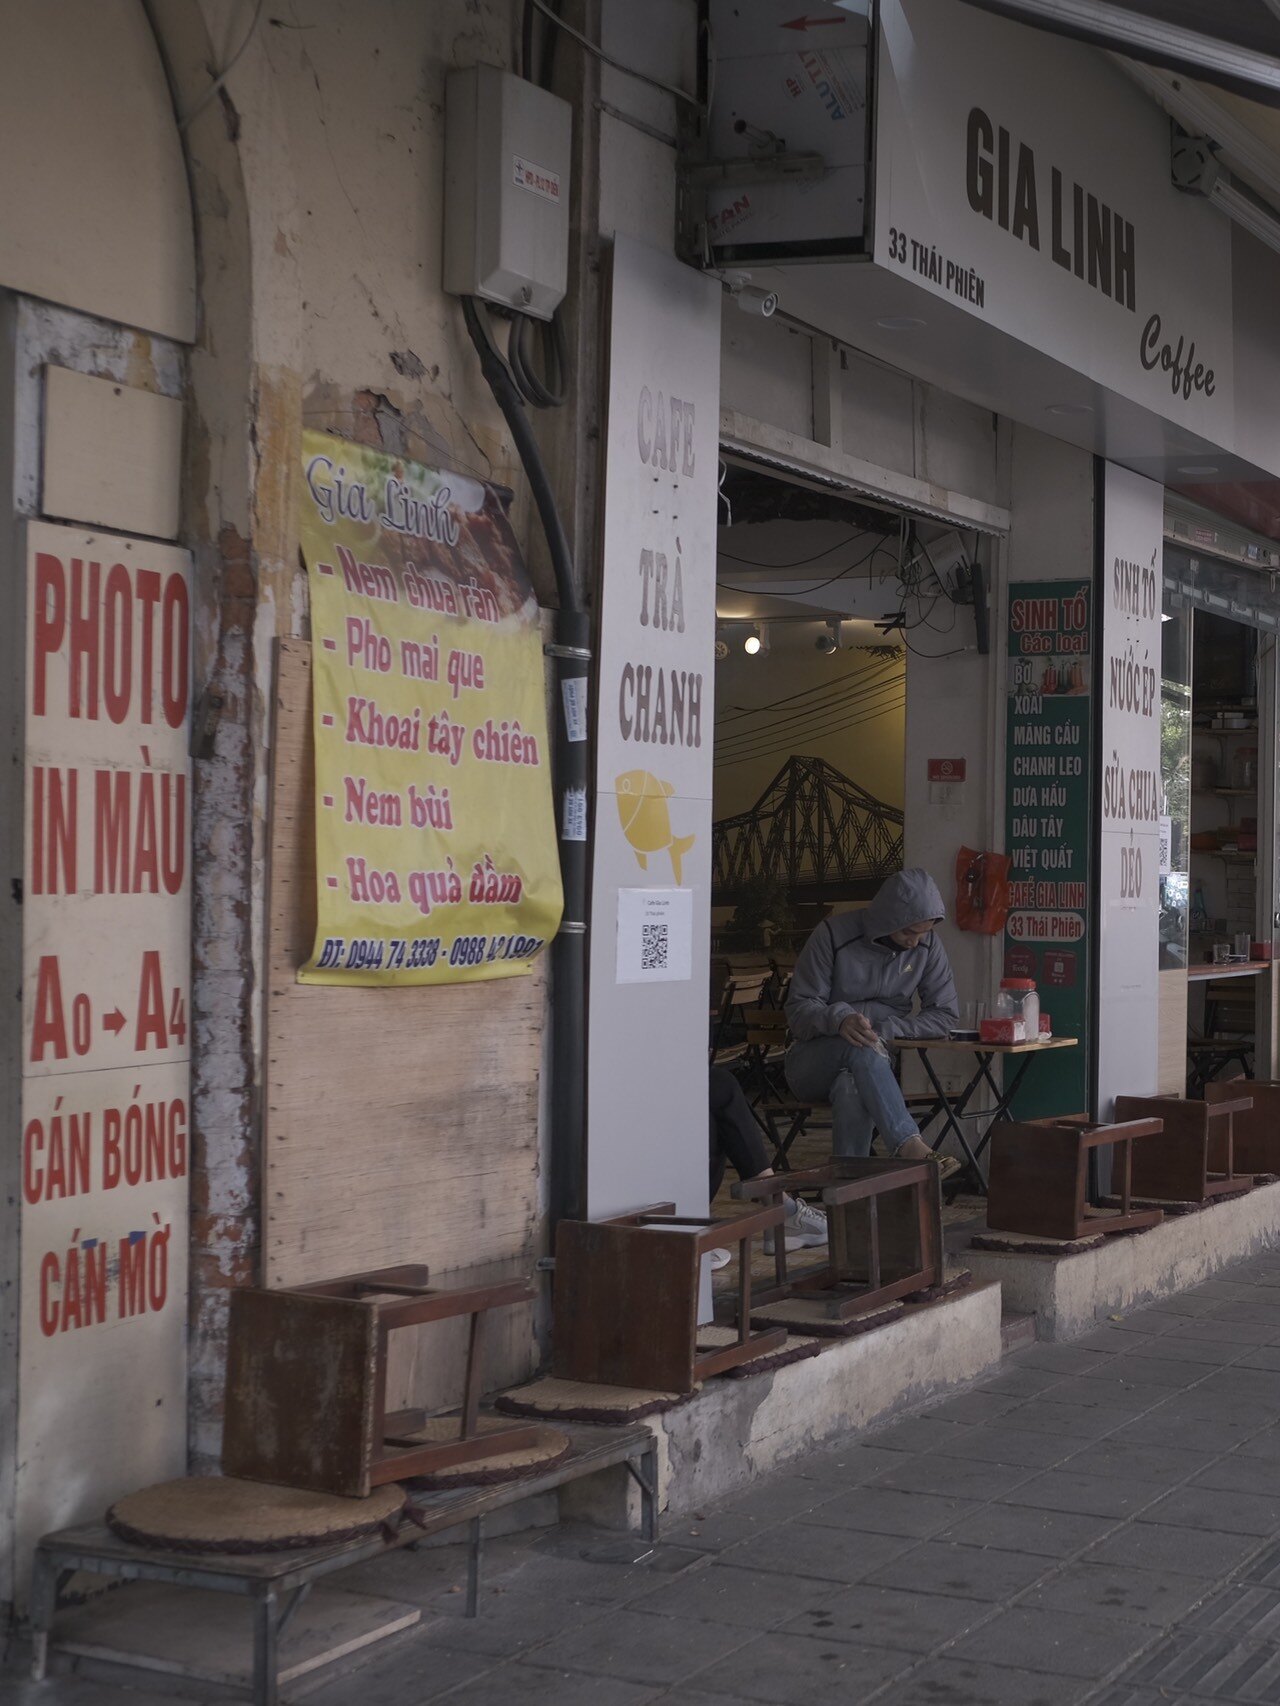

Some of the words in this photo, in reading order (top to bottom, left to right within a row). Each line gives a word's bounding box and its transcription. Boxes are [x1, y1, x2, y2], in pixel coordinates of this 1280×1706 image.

[966, 106, 1041, 252] GIA
[1051, 165, 1136, 313] LINH
[888, 227, 907, 265] 33
[911, 237, 943, 286] THÁI
[945, 259, 985, 309] PHIÊN
[1139, 313, 1216, 401] Coffee
[638, 385, 696, 479] CAFE
[306, 455, 371, 523] Gia
[381, 478, 459, 547] Linh
[336, 544, 398, 602] Nem
[404, 562, 458, 617] chua
[458, 577, 500, 624] rán
[639, 536, 685, 634] TRÀ
[1011, 598, 1058, 632] SINH
[1062, 585, 1089, 631] TỐ
[1113, 556, 1140, 617] SINH
[1142, 548, 1157, 621] TỐ
[33, 551, 189, 730] PHOTO
[346, 617, 392, 673] Pho
[401, 634, 439, 682] mai
[447, 649, 485, 699] que
[1014, 663, 1033, 685] BƠ
[1020, 632, 1052, 653] Các
[1056, 632, 1088, 656] loại
[619, 661, 702, 748] CHANH
[1014, 692, 1043, 715] XOÀI
[1110, 644, 1140, 715] NƯỚC
[1142, 649, 1156, 719] ÉP
[345, 696, 421, 751] Khoai
[427, 710, 465, 766] tây
[472, 719, 540, 766] chiên
[1013, 756, 1056, 776] CHANH
[1059, 756, 1082, 776] LEO
[1054, 718, 1080, 745] CẦU
[31, 765, 78, 897] IN
[93, 745, 187, 897] MÀU
[344, 776, 401, 827] Nem
[407, 785, 453, 830] bùi
[1013, 786, 1038, 807] DƯA
[1041, 780, 1066, 807] HẤU
[1103, 749, 1127, 821] SỮA
[1128, 768, 1158, 823] CHUA
[1012, 814, 1037, 838] DÂU
[1041, 814, 1064, 838] TÂY
[1012, 845, 1038, 872] VIỆT
[1041, 841, 1073, 870] QUẤT
[346, 856, 401, 903] Hoa
[408, 855, 462, 915] quả
[1036, 881, 1057, 909] GIA
[1058, 881, 1087, 909] LINH
[317, 938, 345, 969] ĐT:
[346, 938, 384, 970] 0944
[385, 938, 405, 970] 74
[450, 935, 486, 966] 0988
[1010, 915, 1024, 937] 33
[1026, 914, 1049, 937] Thái
[1051, 915, 1082, 938] Phiên
[134, 950, 187, 1053] A4
[23, 1096, 92, 1205] CÁN
[102, 1085, 187, 1193] BÓNG
[39, 1229, 107, 1338] CÁN
[118, 1213, 171, 1317] MỜ
